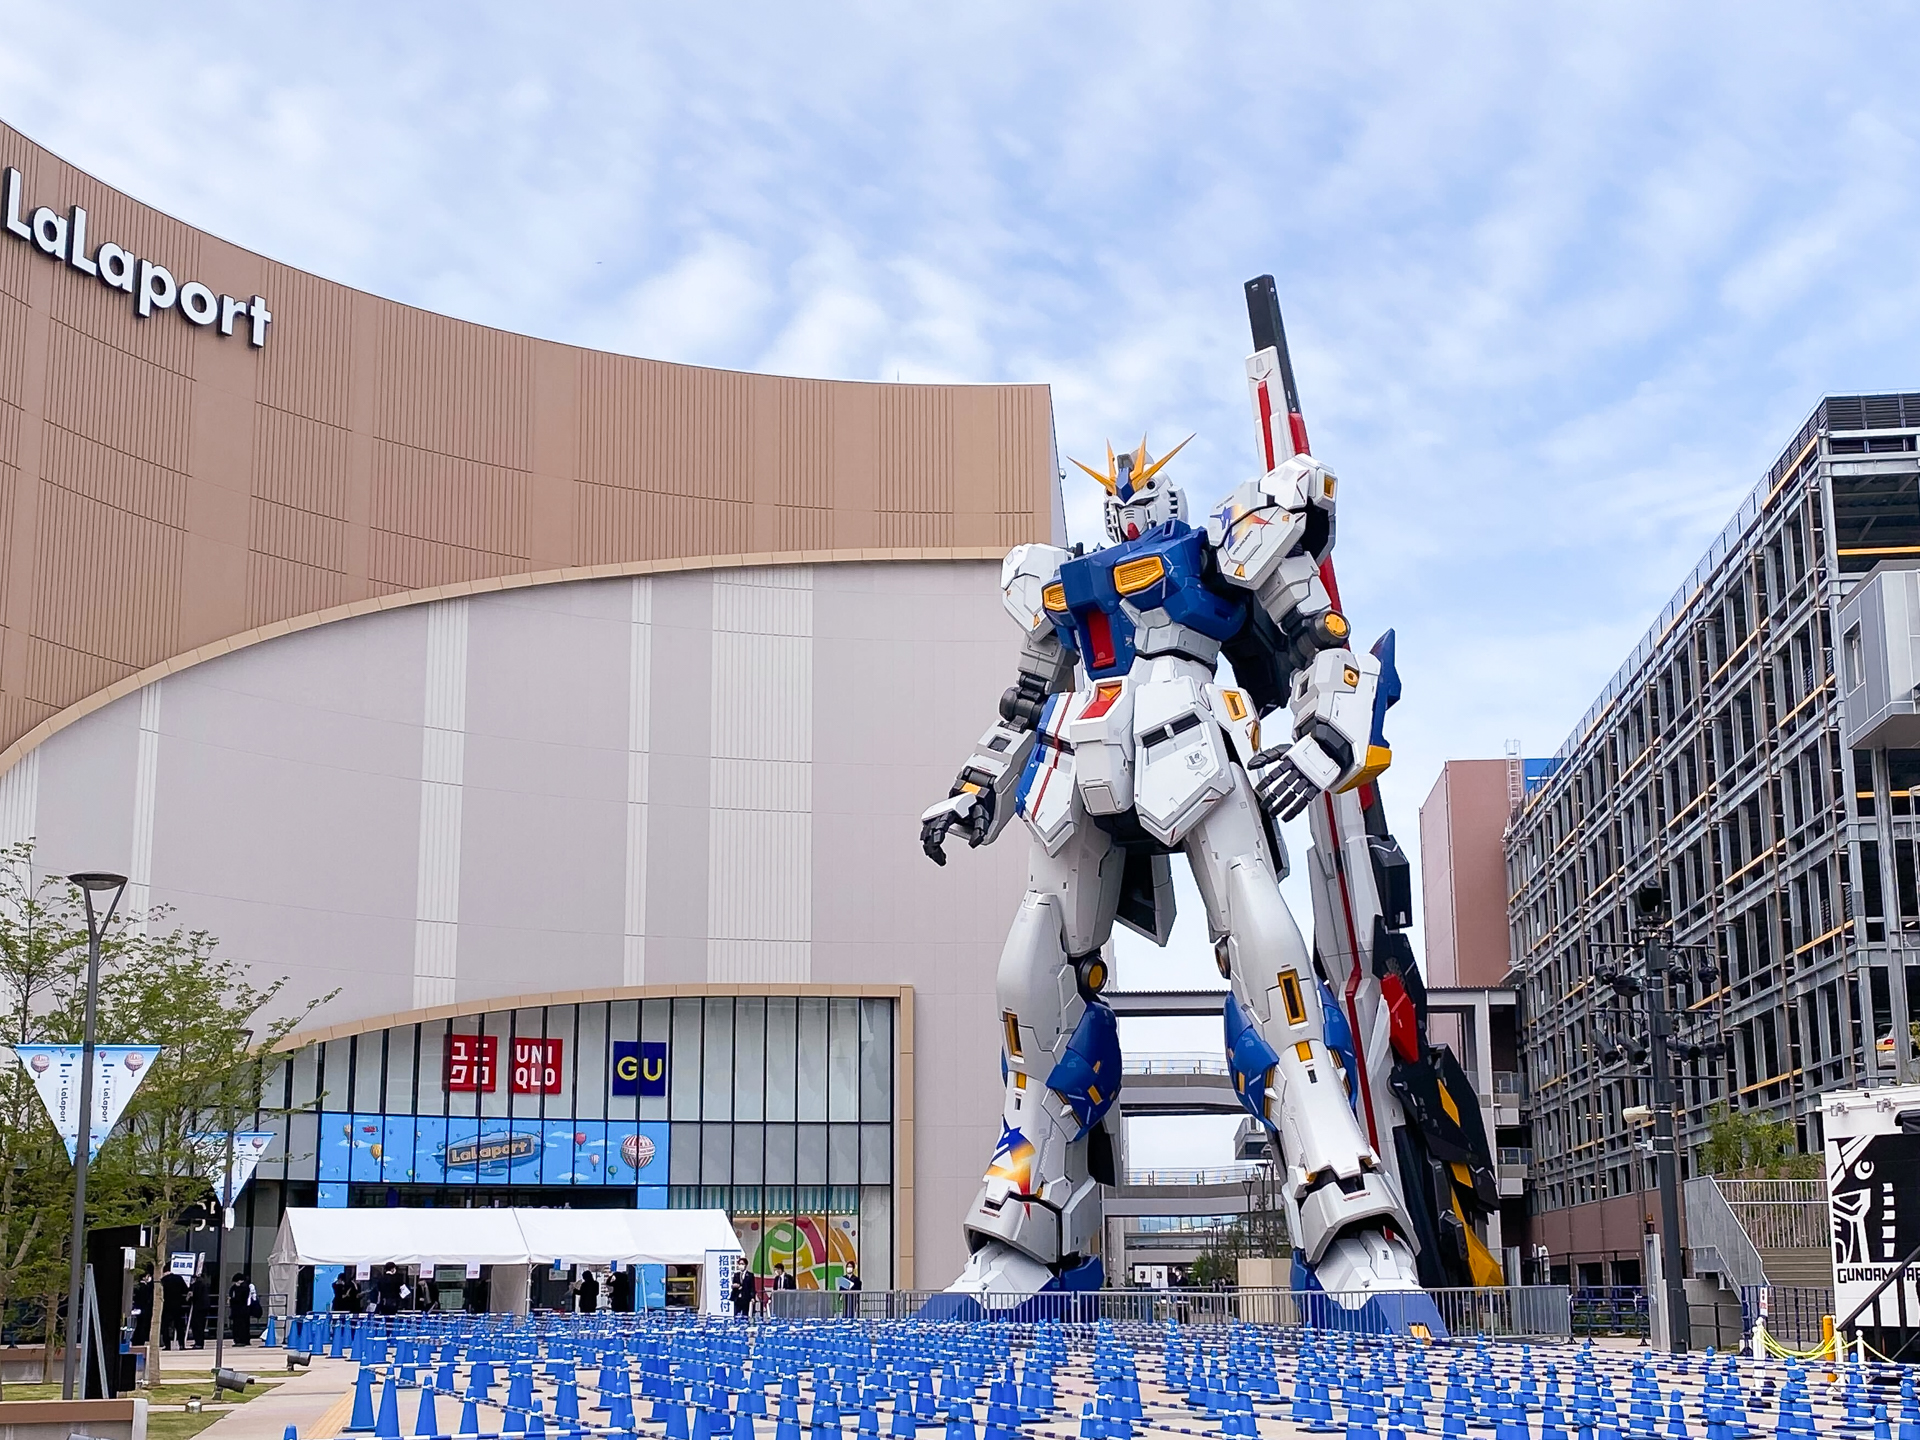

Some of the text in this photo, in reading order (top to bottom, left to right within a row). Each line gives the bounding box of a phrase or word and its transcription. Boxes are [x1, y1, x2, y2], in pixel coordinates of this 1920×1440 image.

[4, 167, 272, 347] LaLaport
[452, 1042, 489, 1061] ユニ
[516, 1045, 553, 1063] UNI
[515, 1067, 556, 1089] QLO
[617, 1056, 663, 1081] GU
[719, 1255, 731, 1313] 招待者受付
